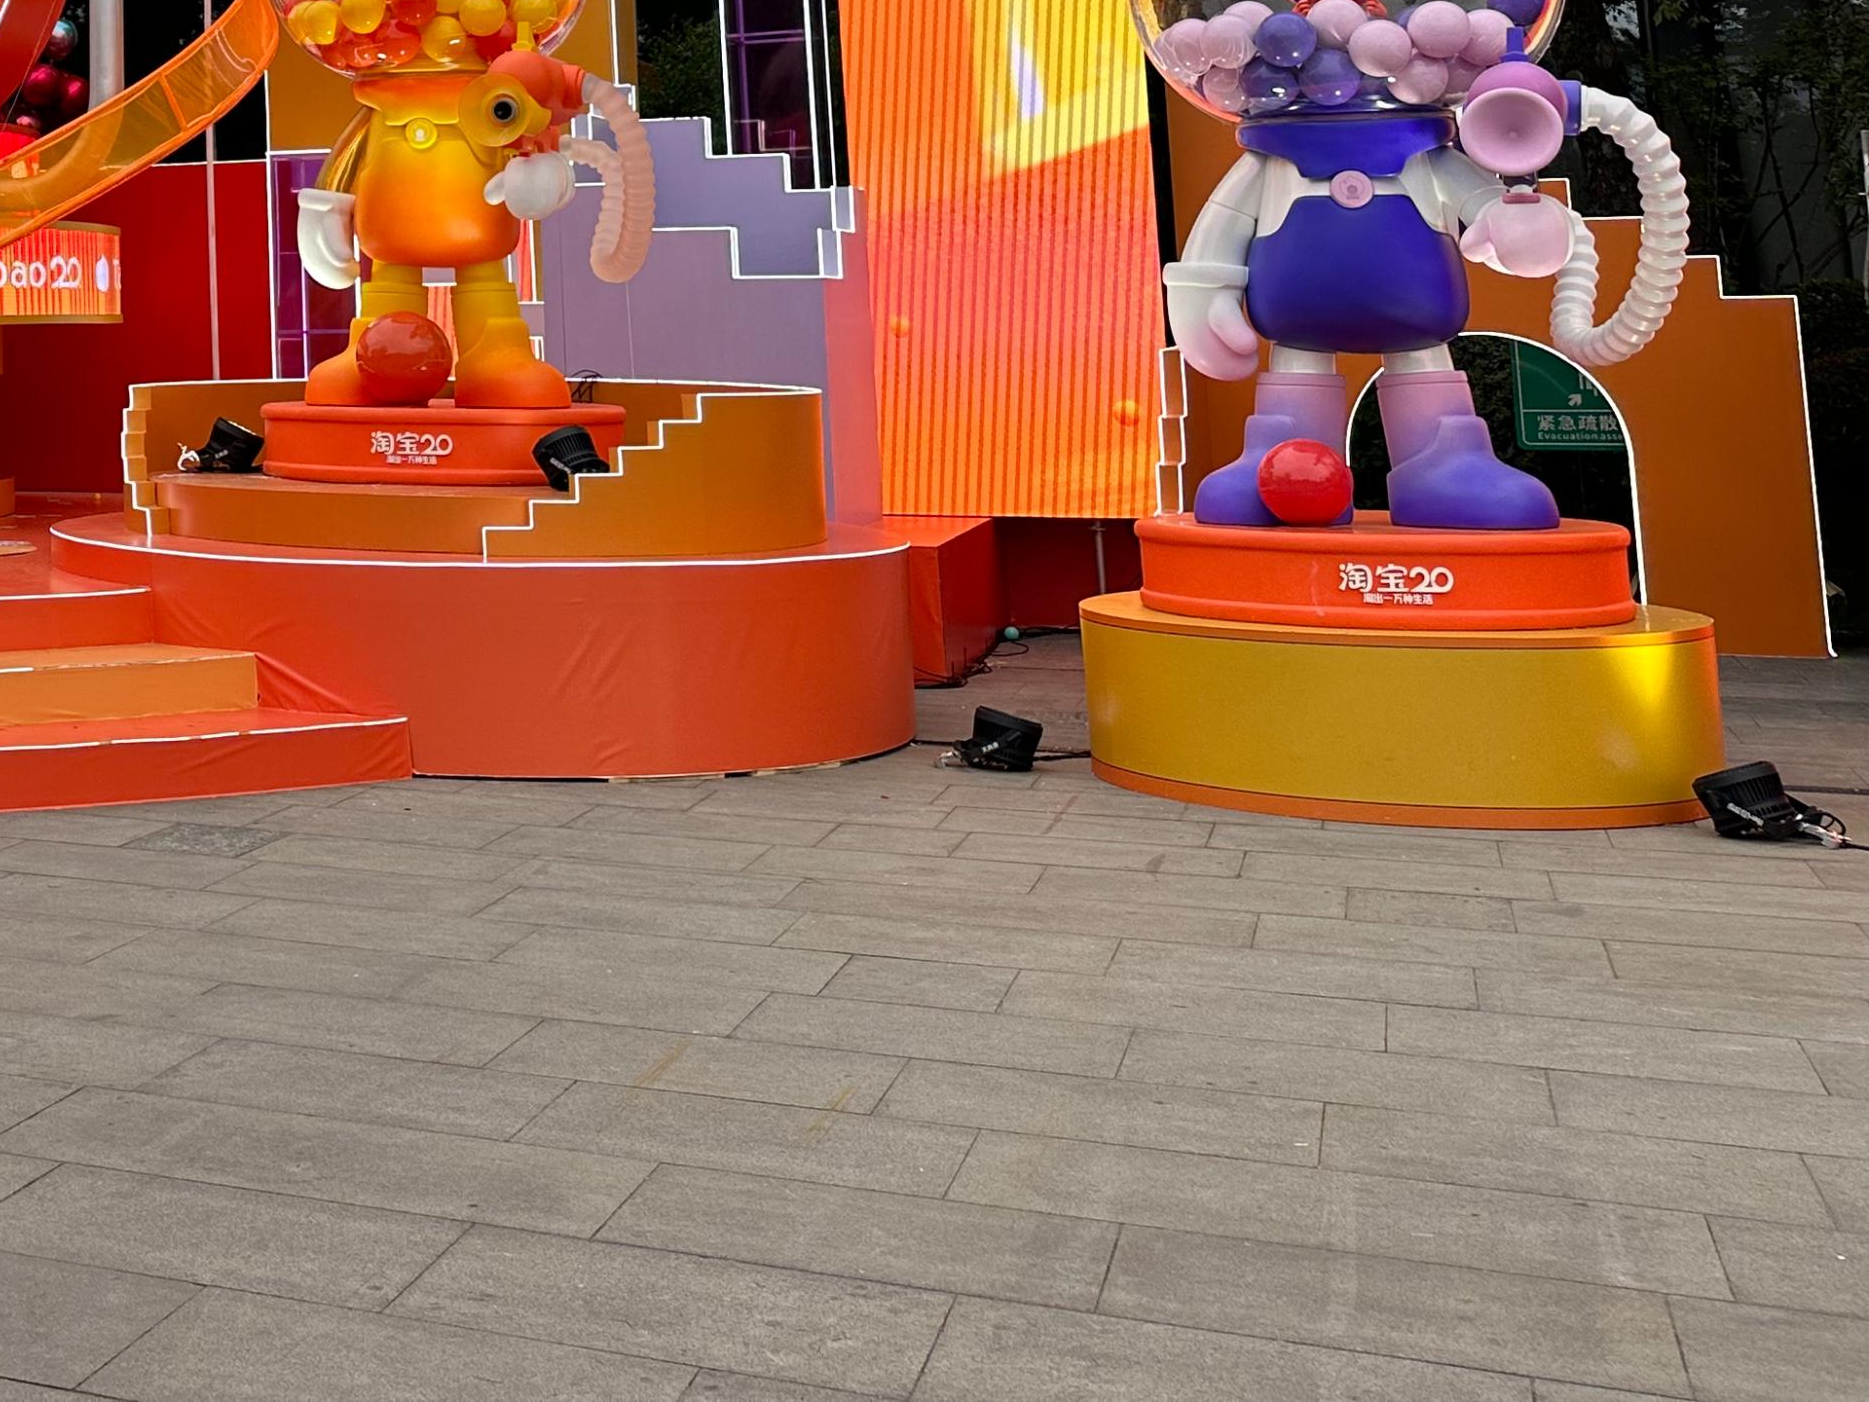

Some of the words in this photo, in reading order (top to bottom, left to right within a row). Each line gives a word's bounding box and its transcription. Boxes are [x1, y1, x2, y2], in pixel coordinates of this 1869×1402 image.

[1537, 414, 1619, 432] 紧急疏散
[370, 430, 454, 456] 淘宝20
[1537, 432, 1598, 441] Evacuation
[1338, 562, 1455, 594] 淘宝20
